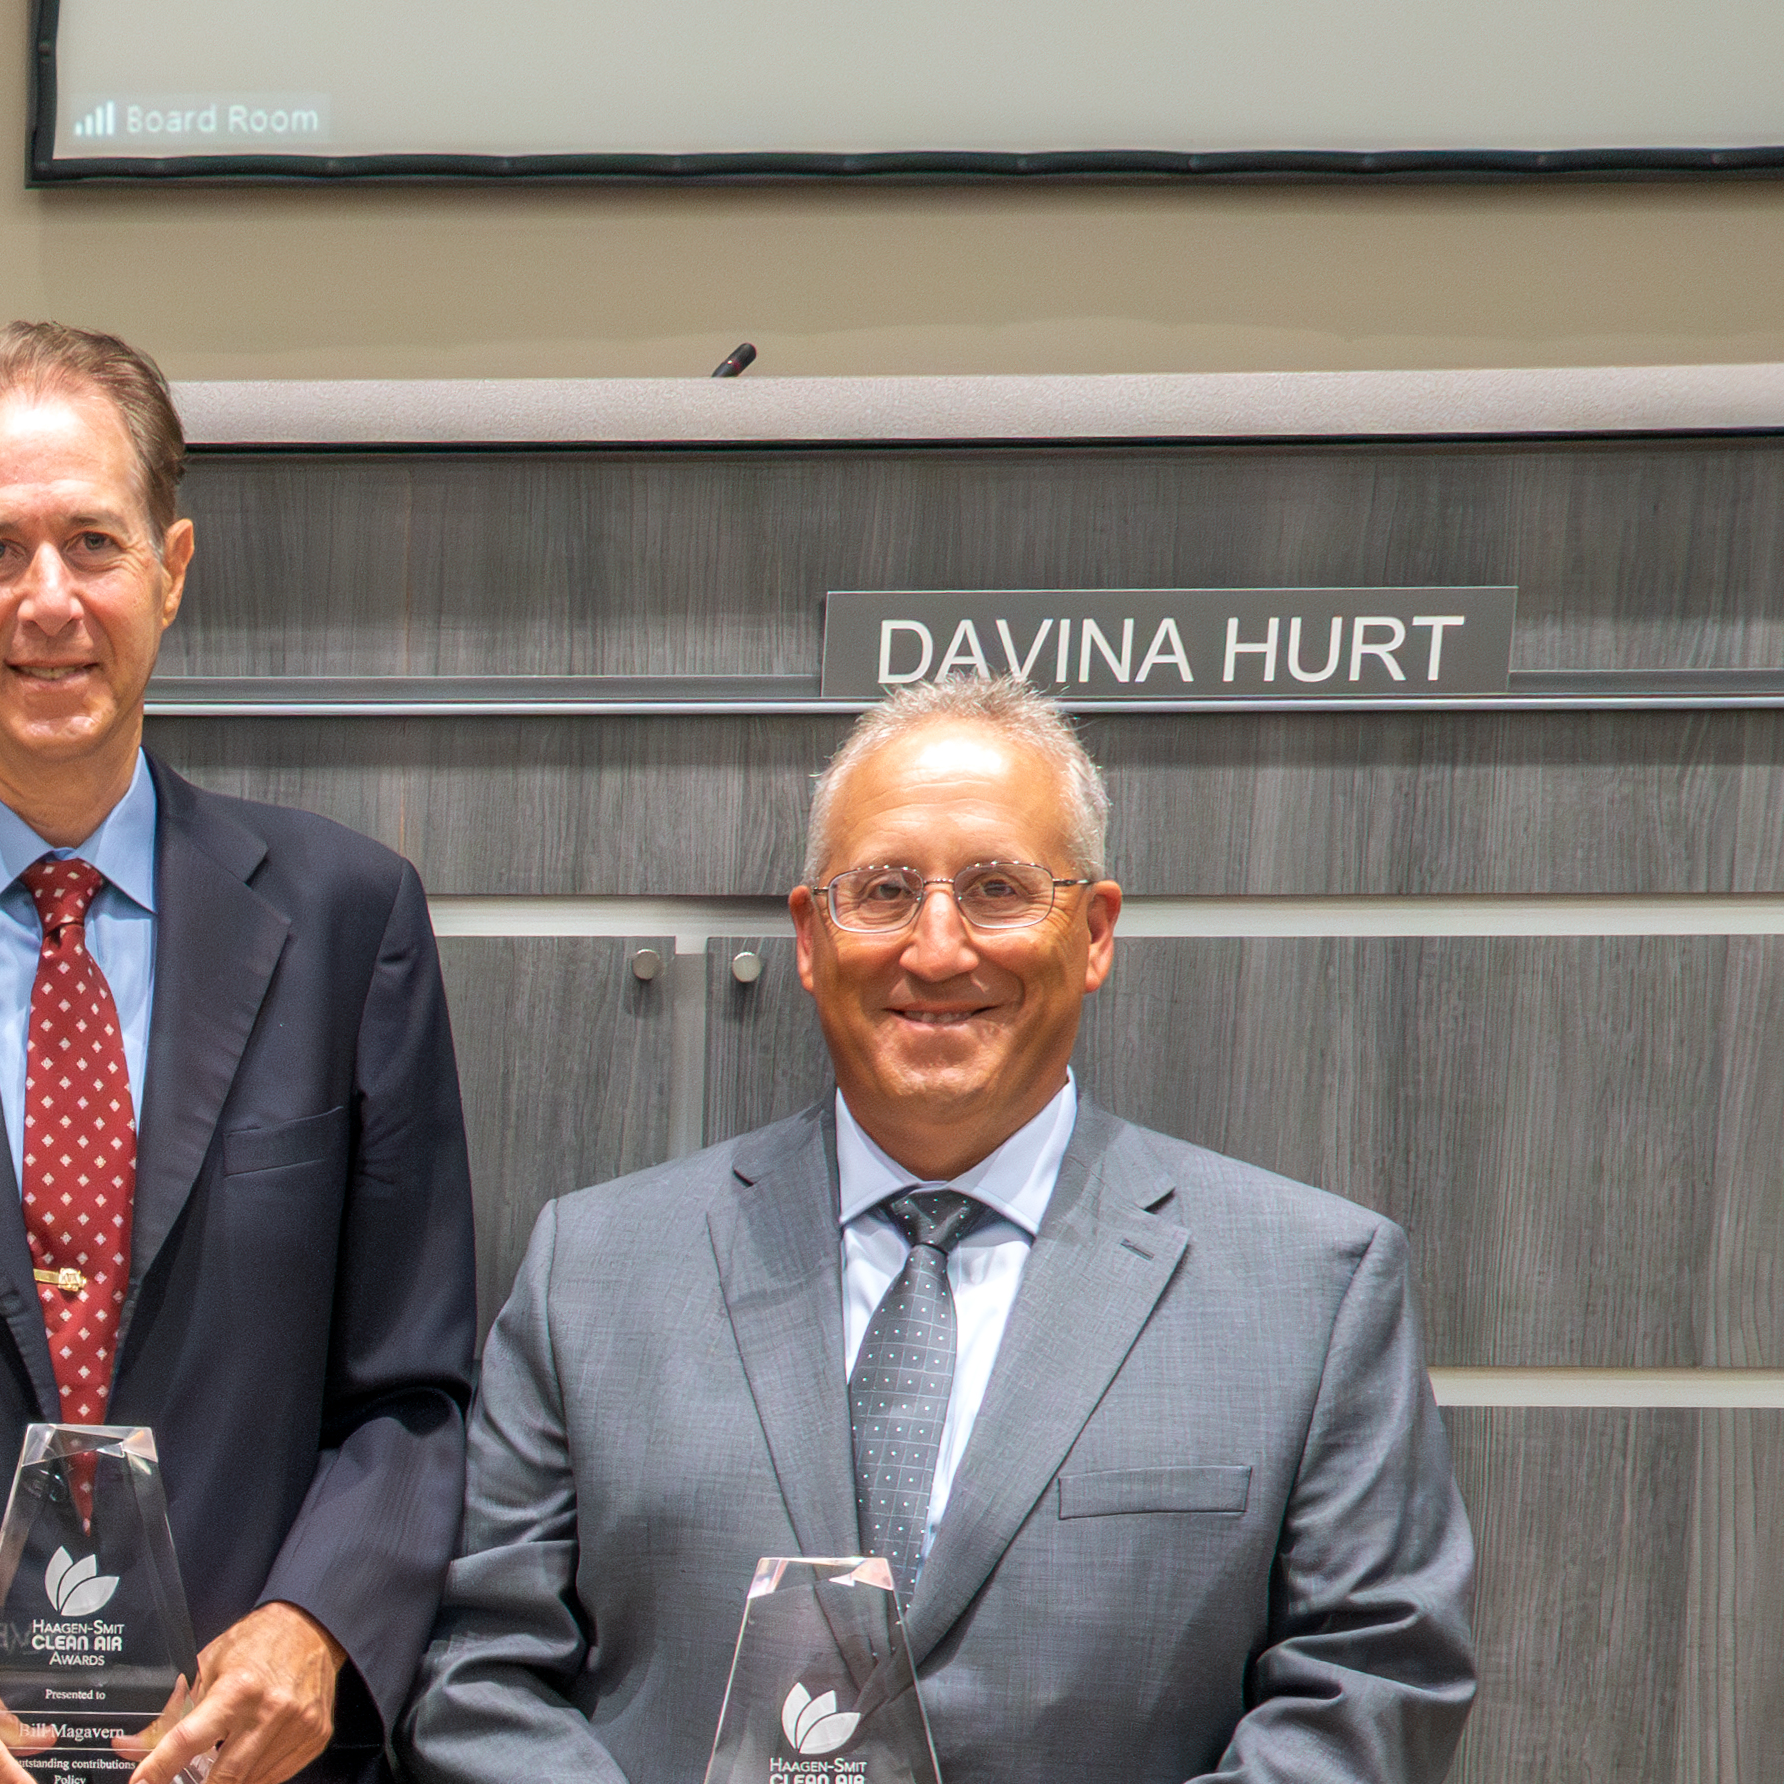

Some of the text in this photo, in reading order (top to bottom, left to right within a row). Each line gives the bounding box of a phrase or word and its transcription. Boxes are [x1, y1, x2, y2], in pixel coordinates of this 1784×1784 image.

[127, 103, 318, 133] Board Room
[878, 616, 1464, 684] DAVINA HURT
[94, 1636, 122, 1651] AIR
[45, 1689, 106, 1700] Presented to
[19, 1723, 124, 1742] Bill Magavern
[18, 1758, 136, 1771] utstanding contributions
